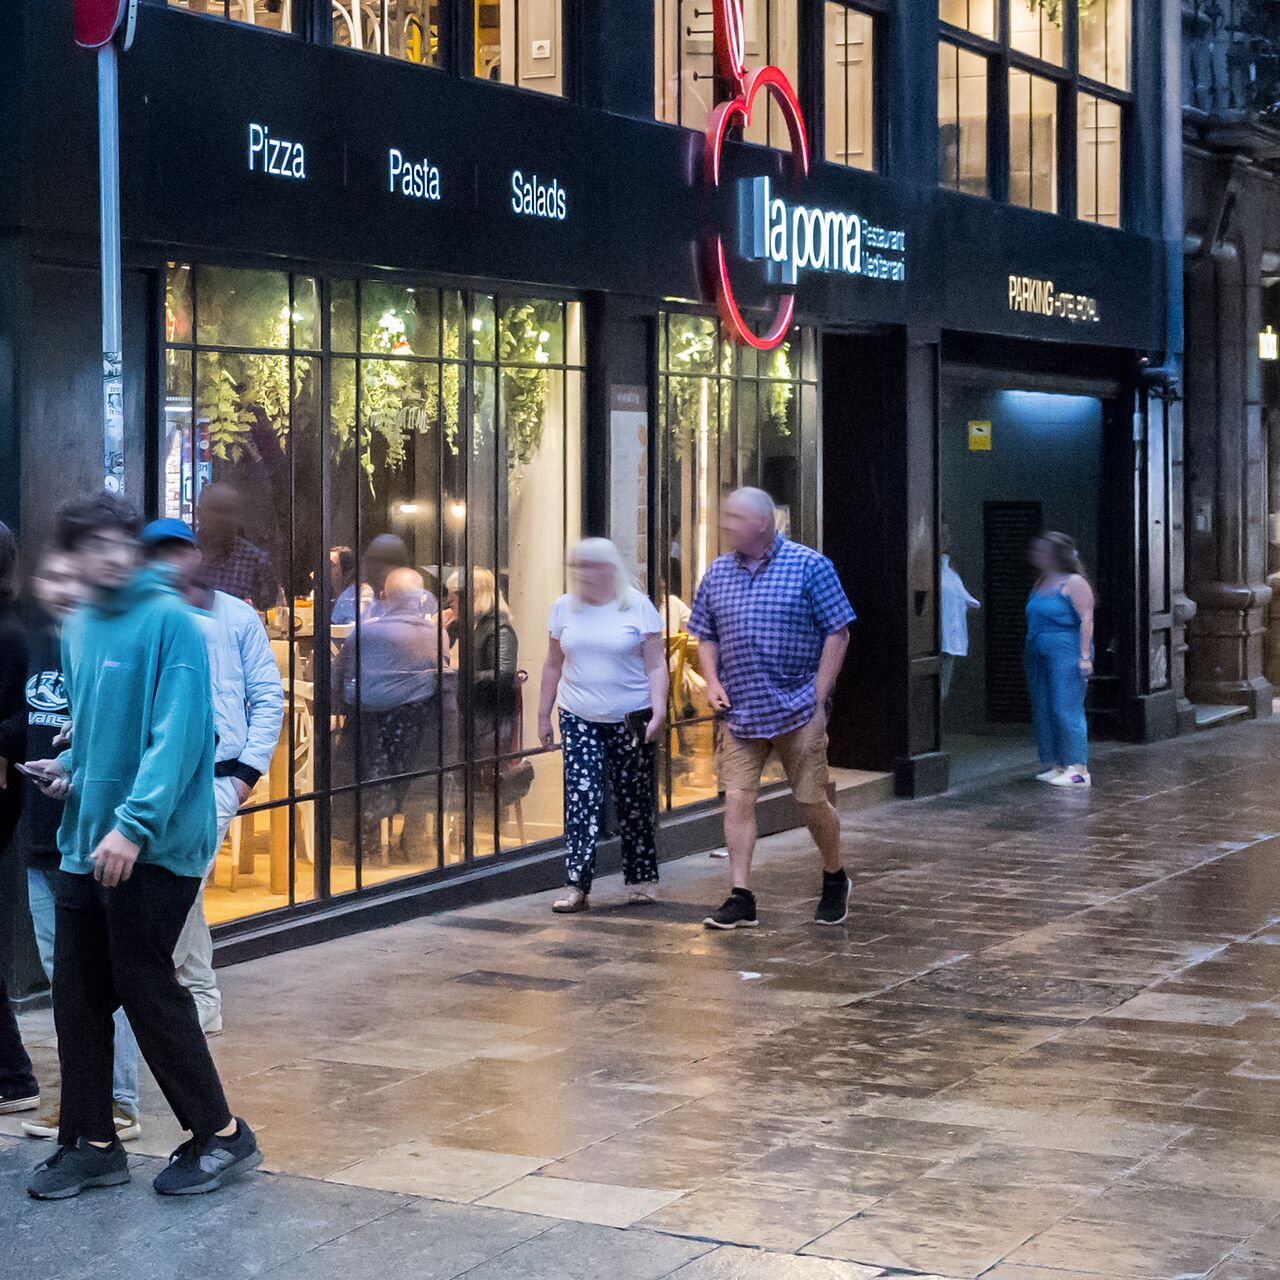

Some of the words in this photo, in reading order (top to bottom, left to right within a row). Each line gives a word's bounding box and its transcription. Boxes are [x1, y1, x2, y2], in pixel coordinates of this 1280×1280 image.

[248, 122, 306, 180] Pizza
[388, 147, 441, 201] Pasta
[511, 169, 567, 221] Salads
[754, 174, 788, 263] la
[790, 206, 862, 285] poma
[1008, 275, 1055, 317] PARKING
